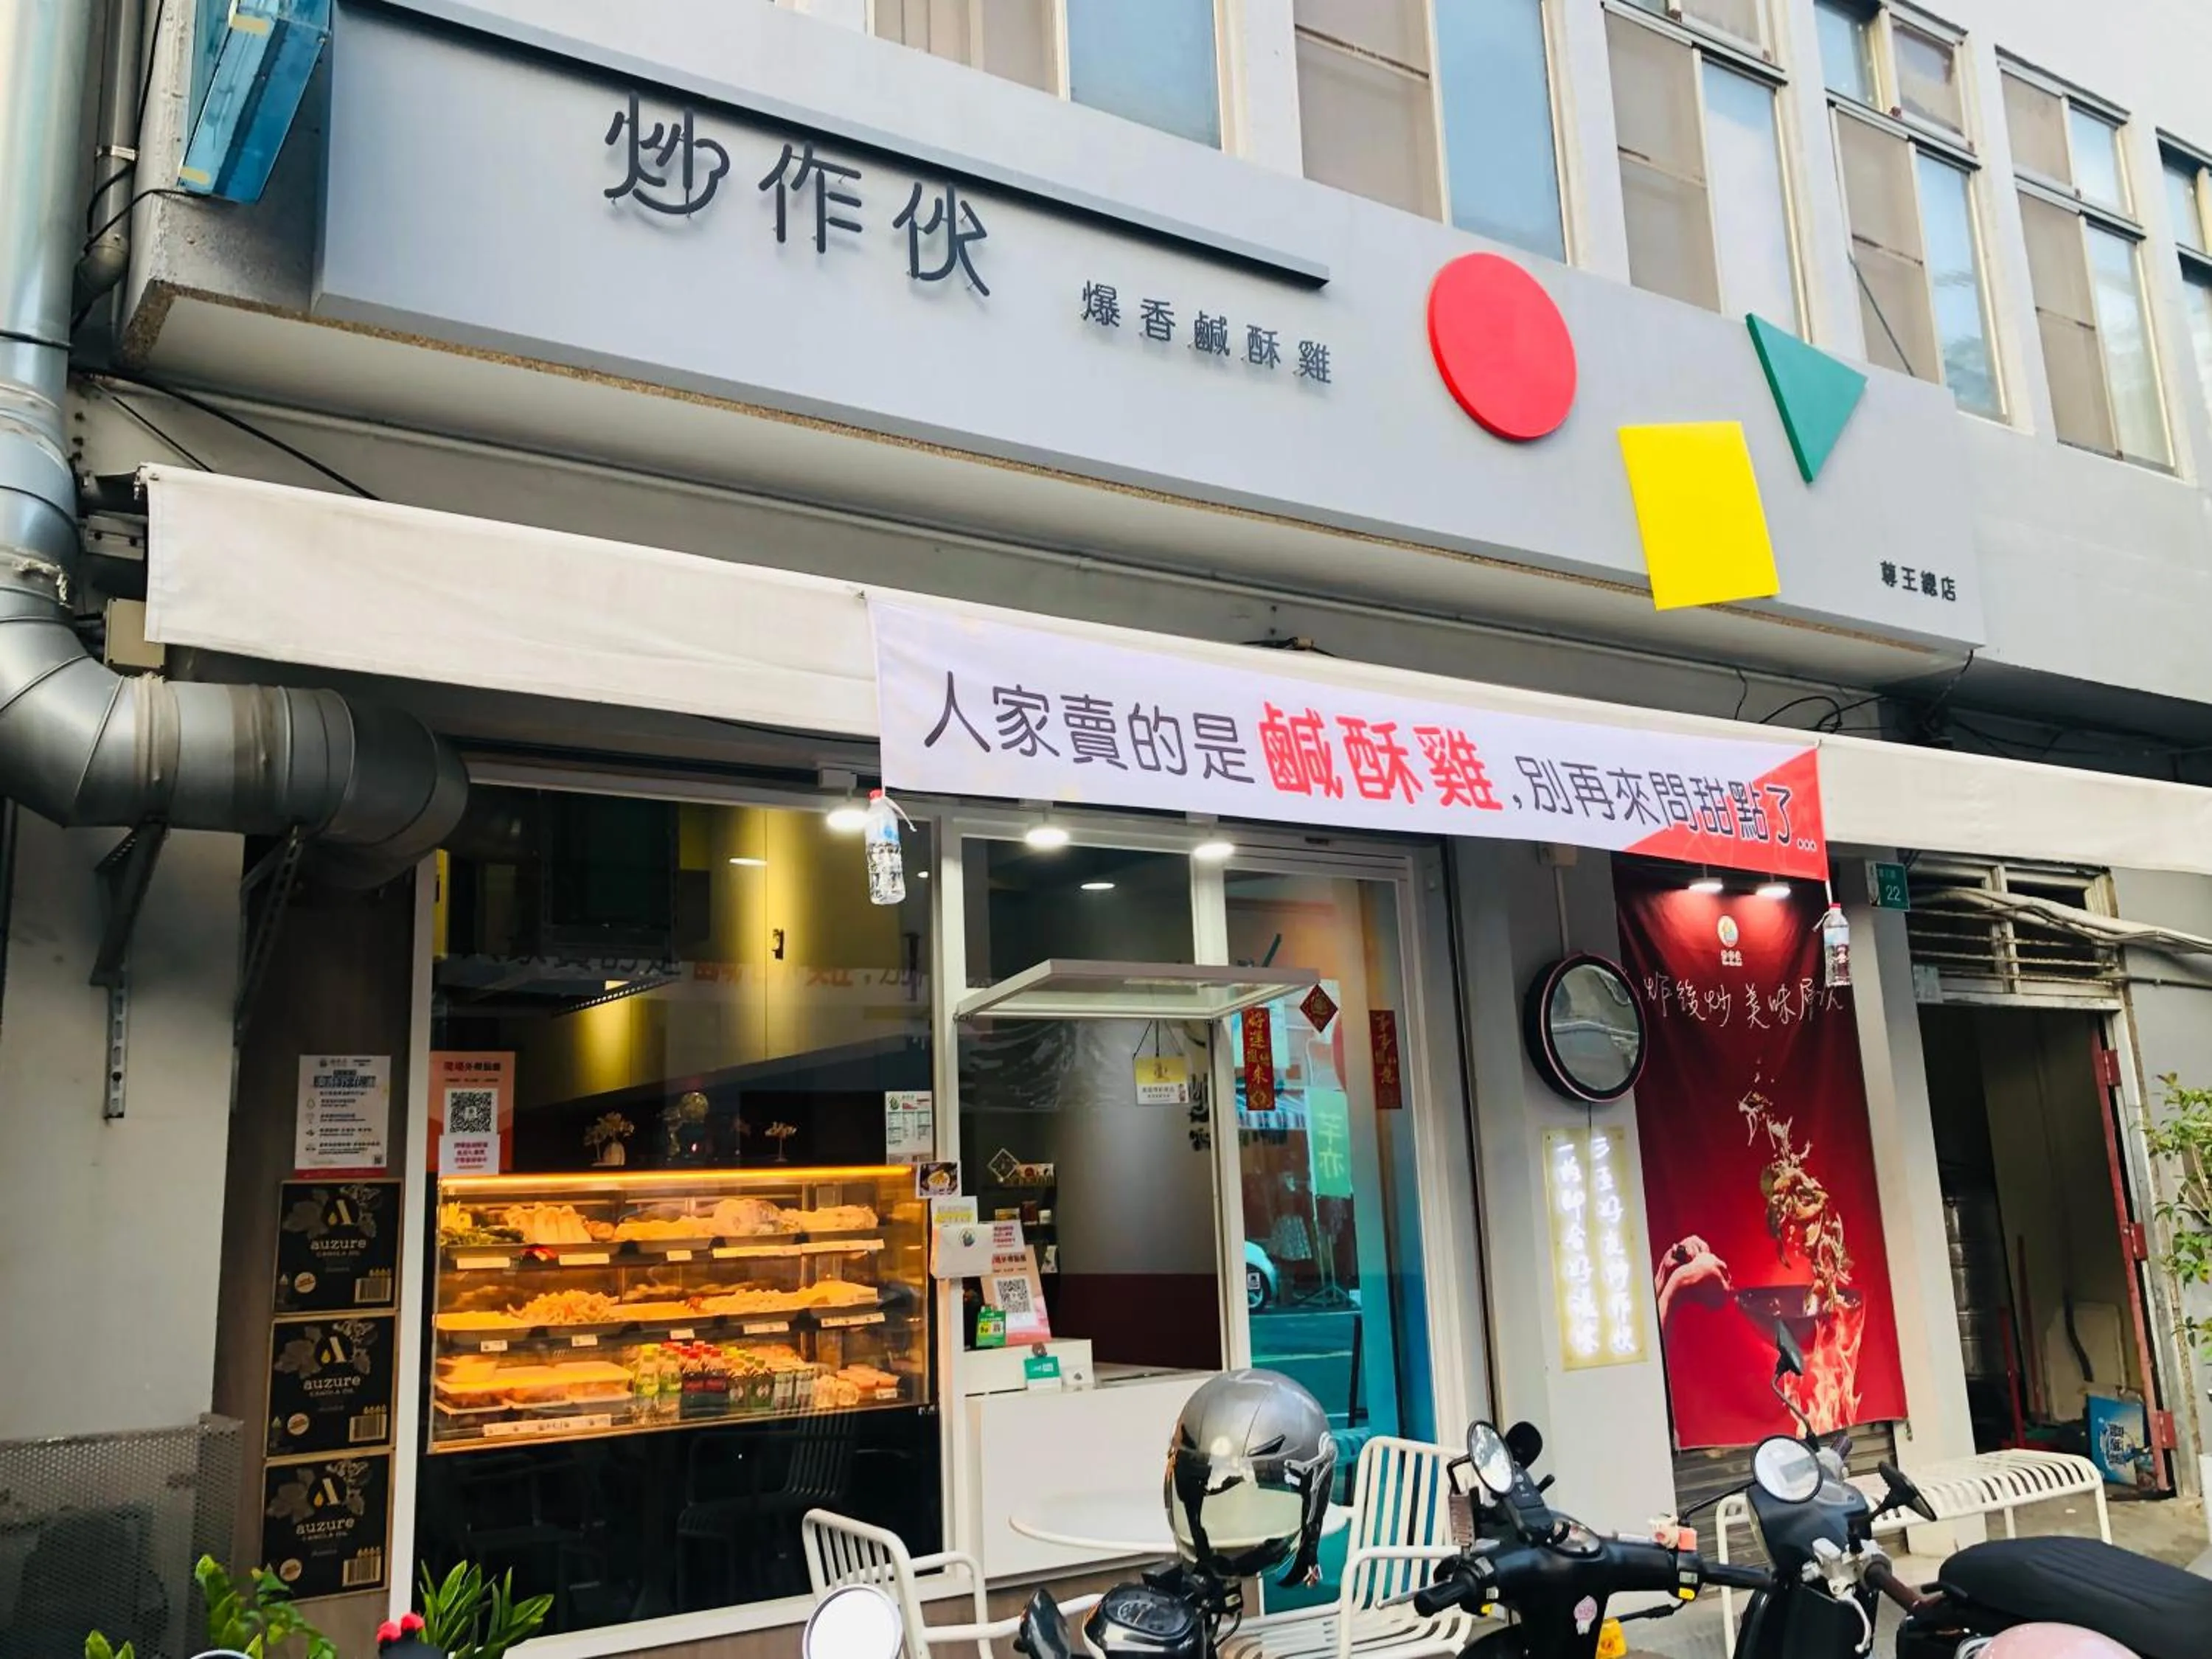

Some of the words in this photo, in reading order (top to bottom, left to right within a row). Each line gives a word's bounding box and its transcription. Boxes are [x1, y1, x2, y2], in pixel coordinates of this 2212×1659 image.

[604, 91, 990, 296] 炒作伙
[1082, 280, 1331, 383] 爆香鹹酥雞
[1880, 560, 1956, 602] 尊王總店
[1885, 885, 1902, 901] 22
[310, 1238, 367, 1251] auzure
[303, 1375, 361, 1391] auzure
[296, 1517, 355, 1534] auzure
